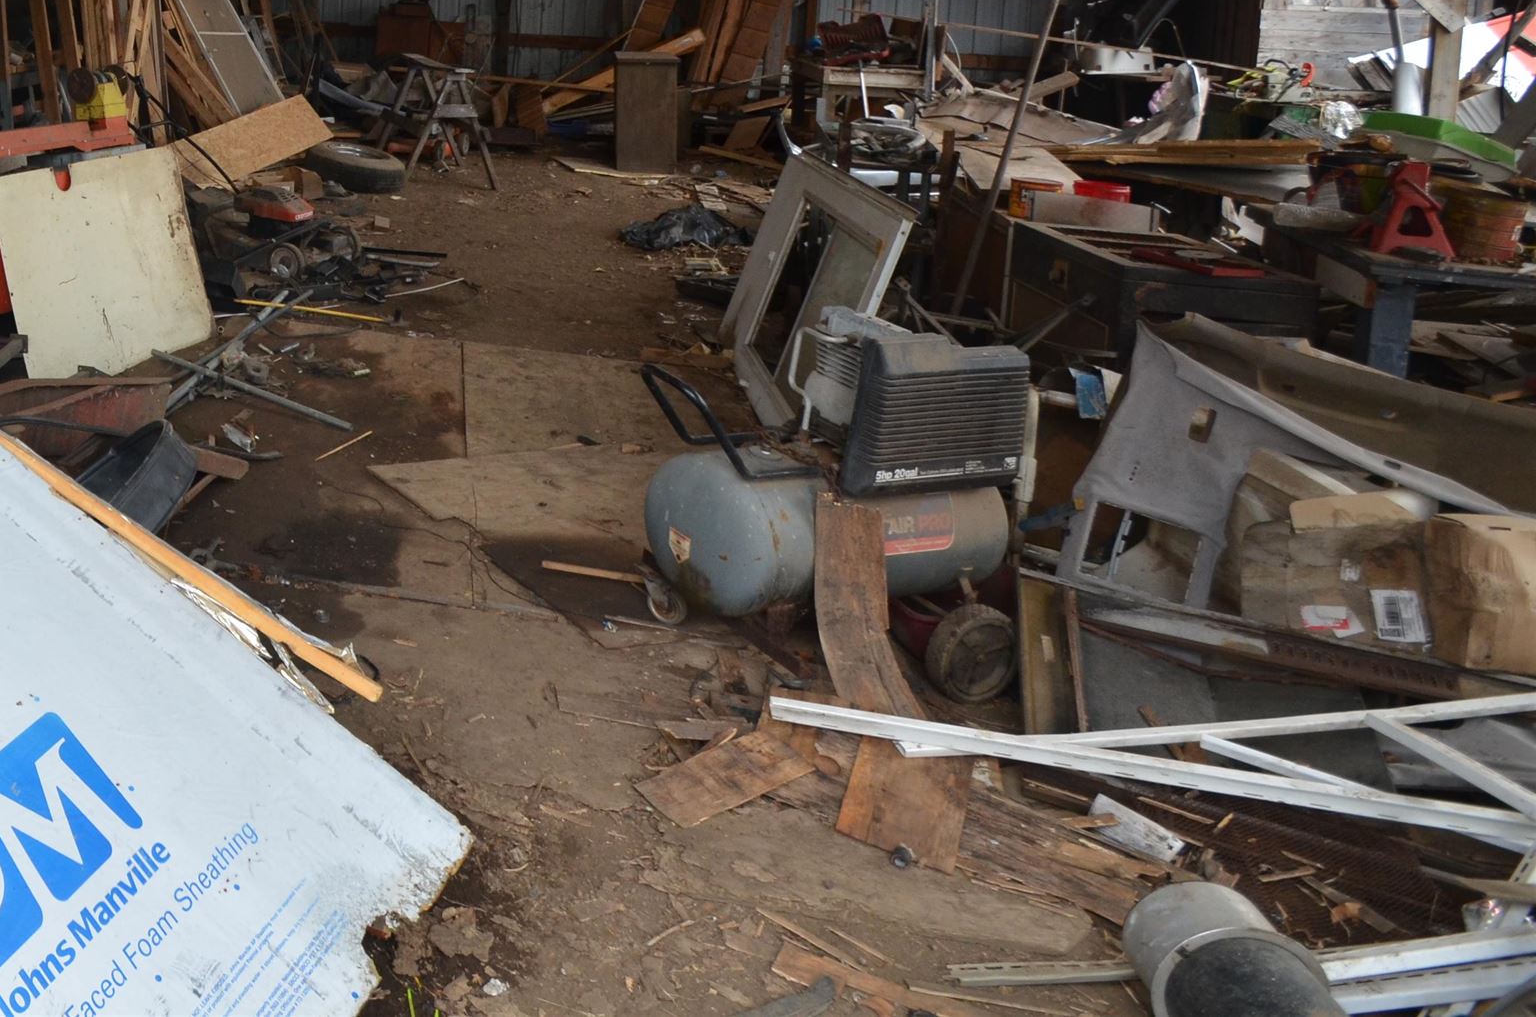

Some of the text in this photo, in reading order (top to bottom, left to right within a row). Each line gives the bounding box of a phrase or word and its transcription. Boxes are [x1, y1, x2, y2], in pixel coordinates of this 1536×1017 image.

[875, 470, 893, 481] 5hp
[894, 466, 919, 480] 20gal
[67, 841, 171, 949] Manville
[122, 910, 178, 971] Foam
[173, 822, 259, 913] Sheathing
